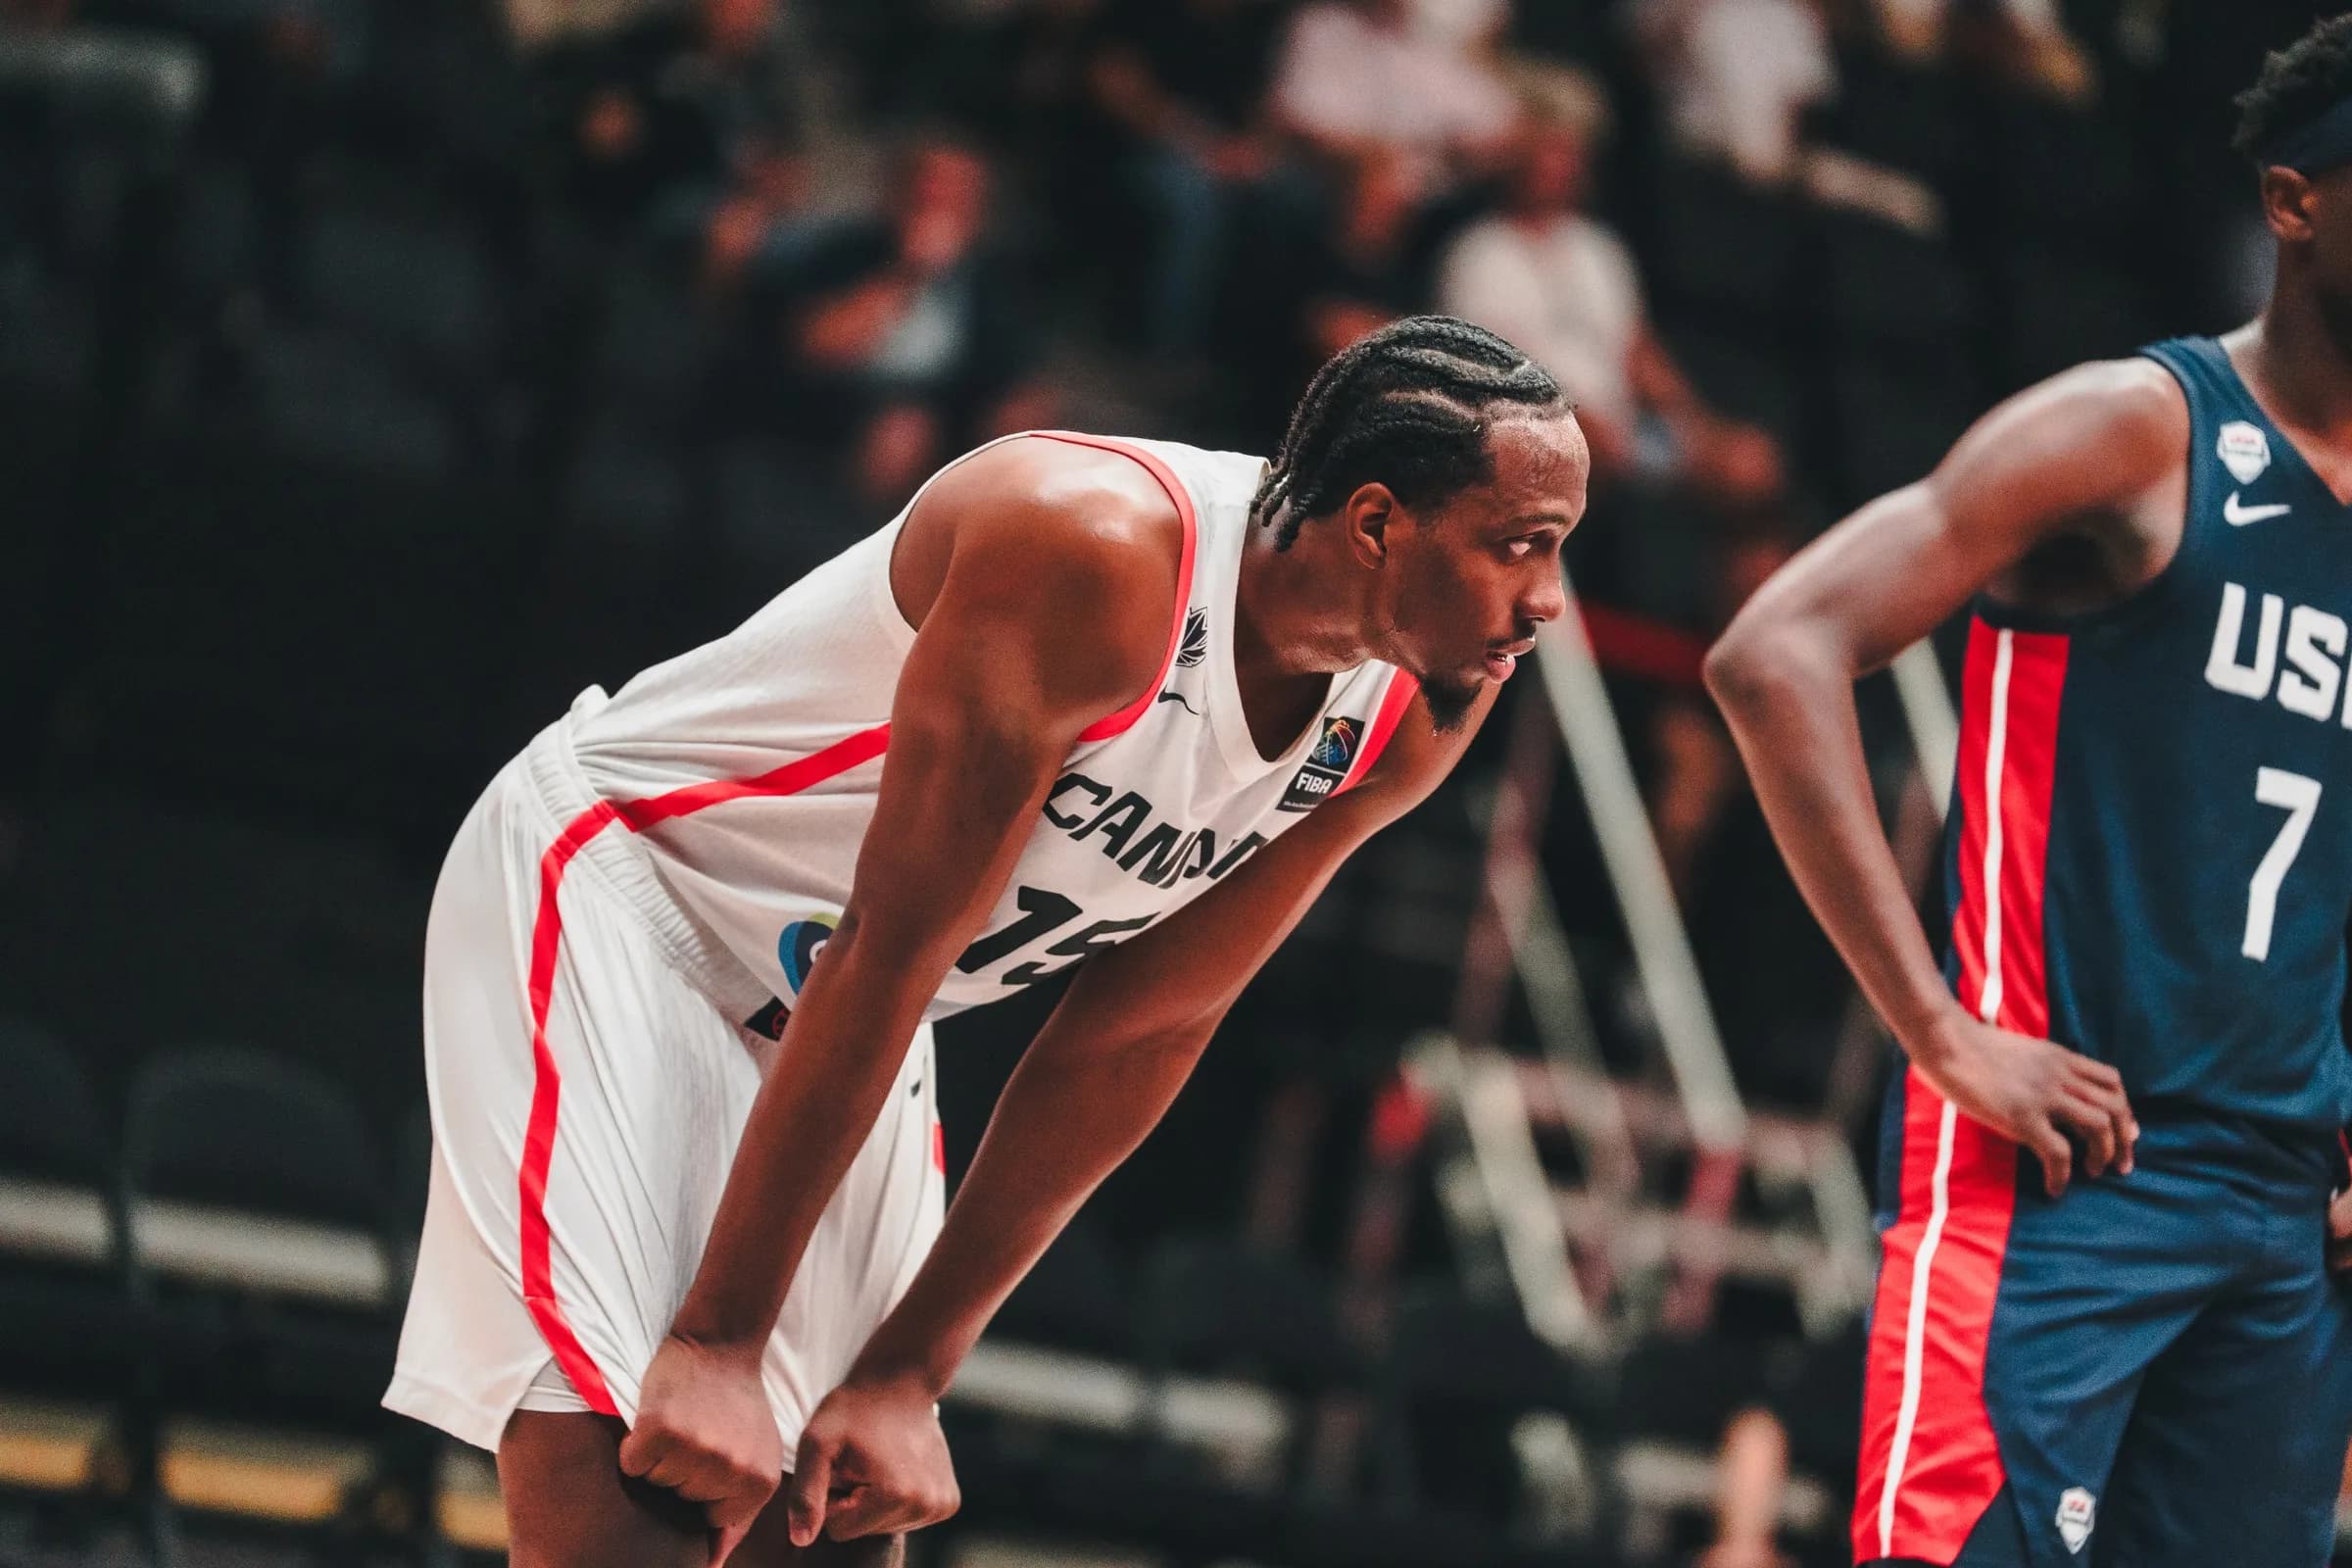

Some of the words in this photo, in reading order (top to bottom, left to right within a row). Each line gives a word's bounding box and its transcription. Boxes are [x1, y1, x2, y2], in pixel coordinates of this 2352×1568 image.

[2204, 581, 2352, 730] US
[1295, 772, 1333, 795] FIBA
[2241, 761, 2323, 961] 7
